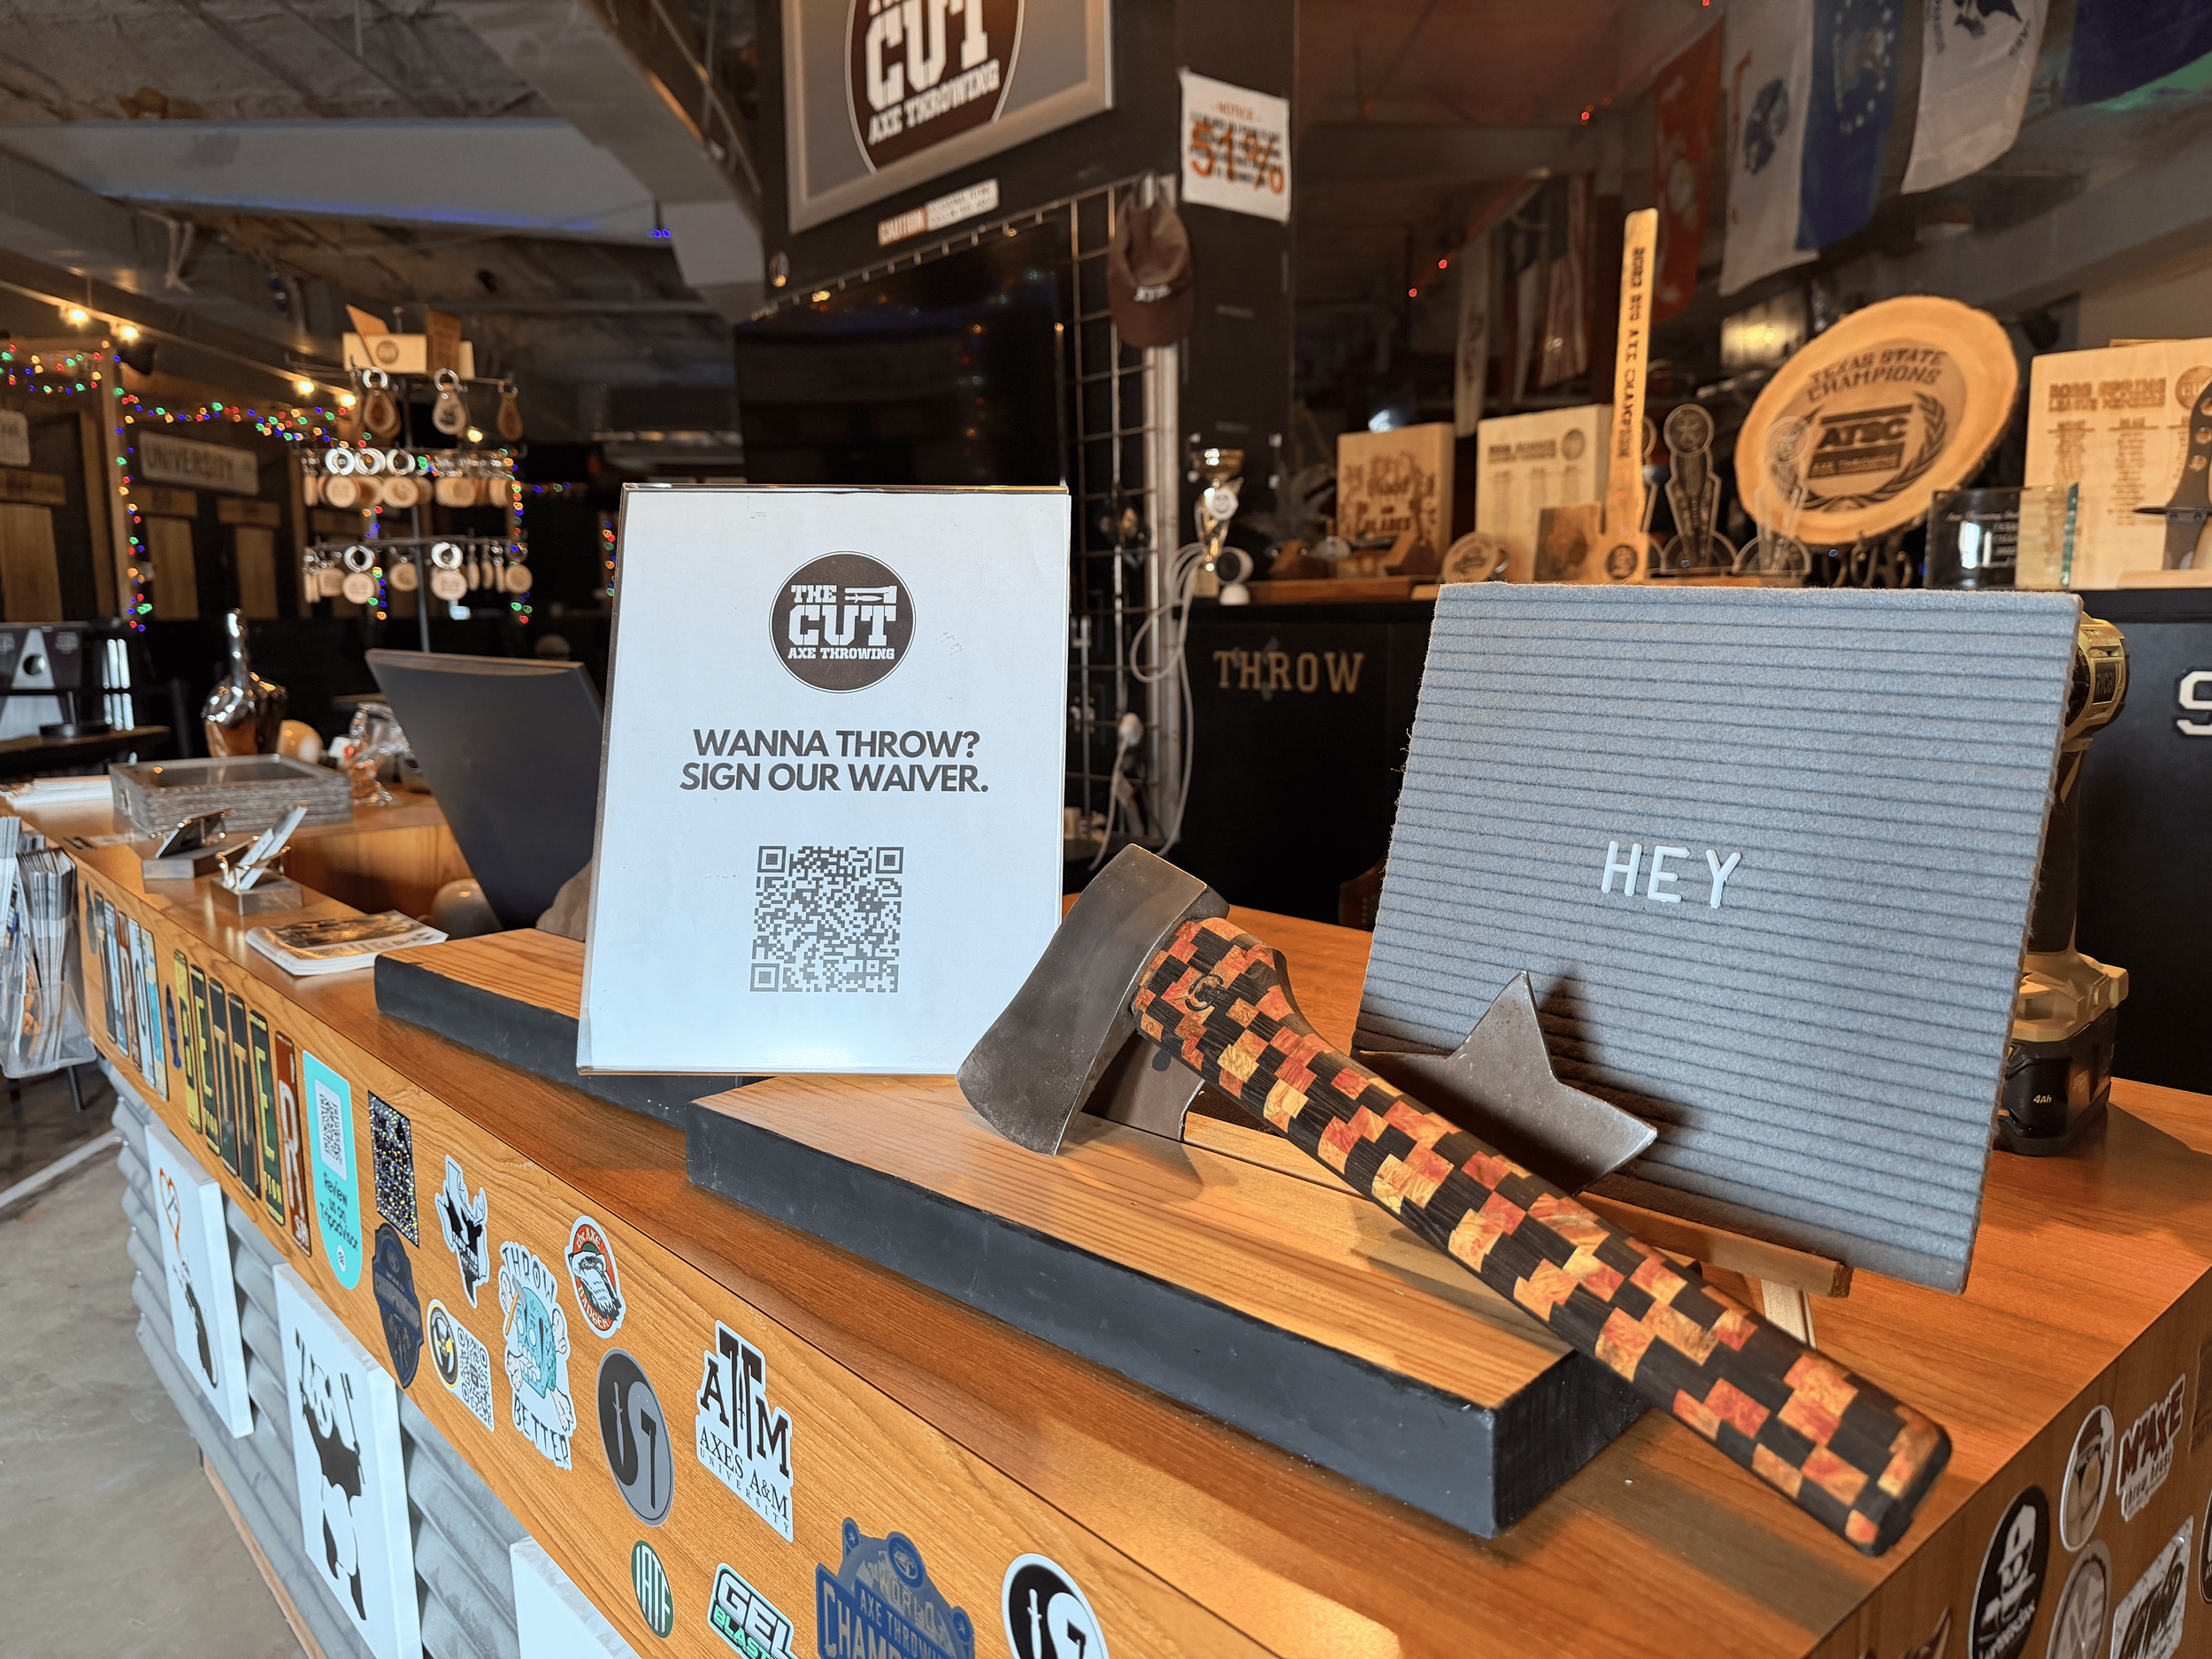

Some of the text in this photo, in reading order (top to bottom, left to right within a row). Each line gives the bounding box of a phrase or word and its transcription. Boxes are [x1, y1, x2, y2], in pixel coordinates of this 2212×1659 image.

[868, 58, 1000, 146] AXE THROWING
[1191, 120, 1284, 195] 51%
[1879, 347, 1949, 366] STATE
[1807, 364, 1942, 403] CHAMPIONS
[790, 584, 838, 603] THE
[787, 604, 896, 647] CUT
[787, 647, 895, 661] AXE THROWING
[1213, 650, 1364, 694] THROW
[692, 728, 981, 758] WANNA THROW?
[679, 762, 989, 793] SIGN OUR WAIVER.
[1601, 841, 1742, 909] HEY
[2032, 1094, 2053, 1104] 4Ah
[323, 1171, 348, 1208] Review
[328, 1196, 348, 1225] us on
[319, 1201, 358, 1252] Tripadvisor
[586, 1226, 602, 1250] AXE
[502, 1238, 556, 1304] THROW
[577, 1285, 610, 1329] BADGER
[513, 1393, 569, 1465] BETTER
[699, 1425, 790, 1522] AXES A&M
[700, 1451, 790, 1534] UNIVERSITY
[718, 1572, 790, 1659] GEL
[860, 1588, 882, 1627] AXE
[879, 1568, 935, 1636] WORLD
[712, 1604, 774, 1659] BLAST
